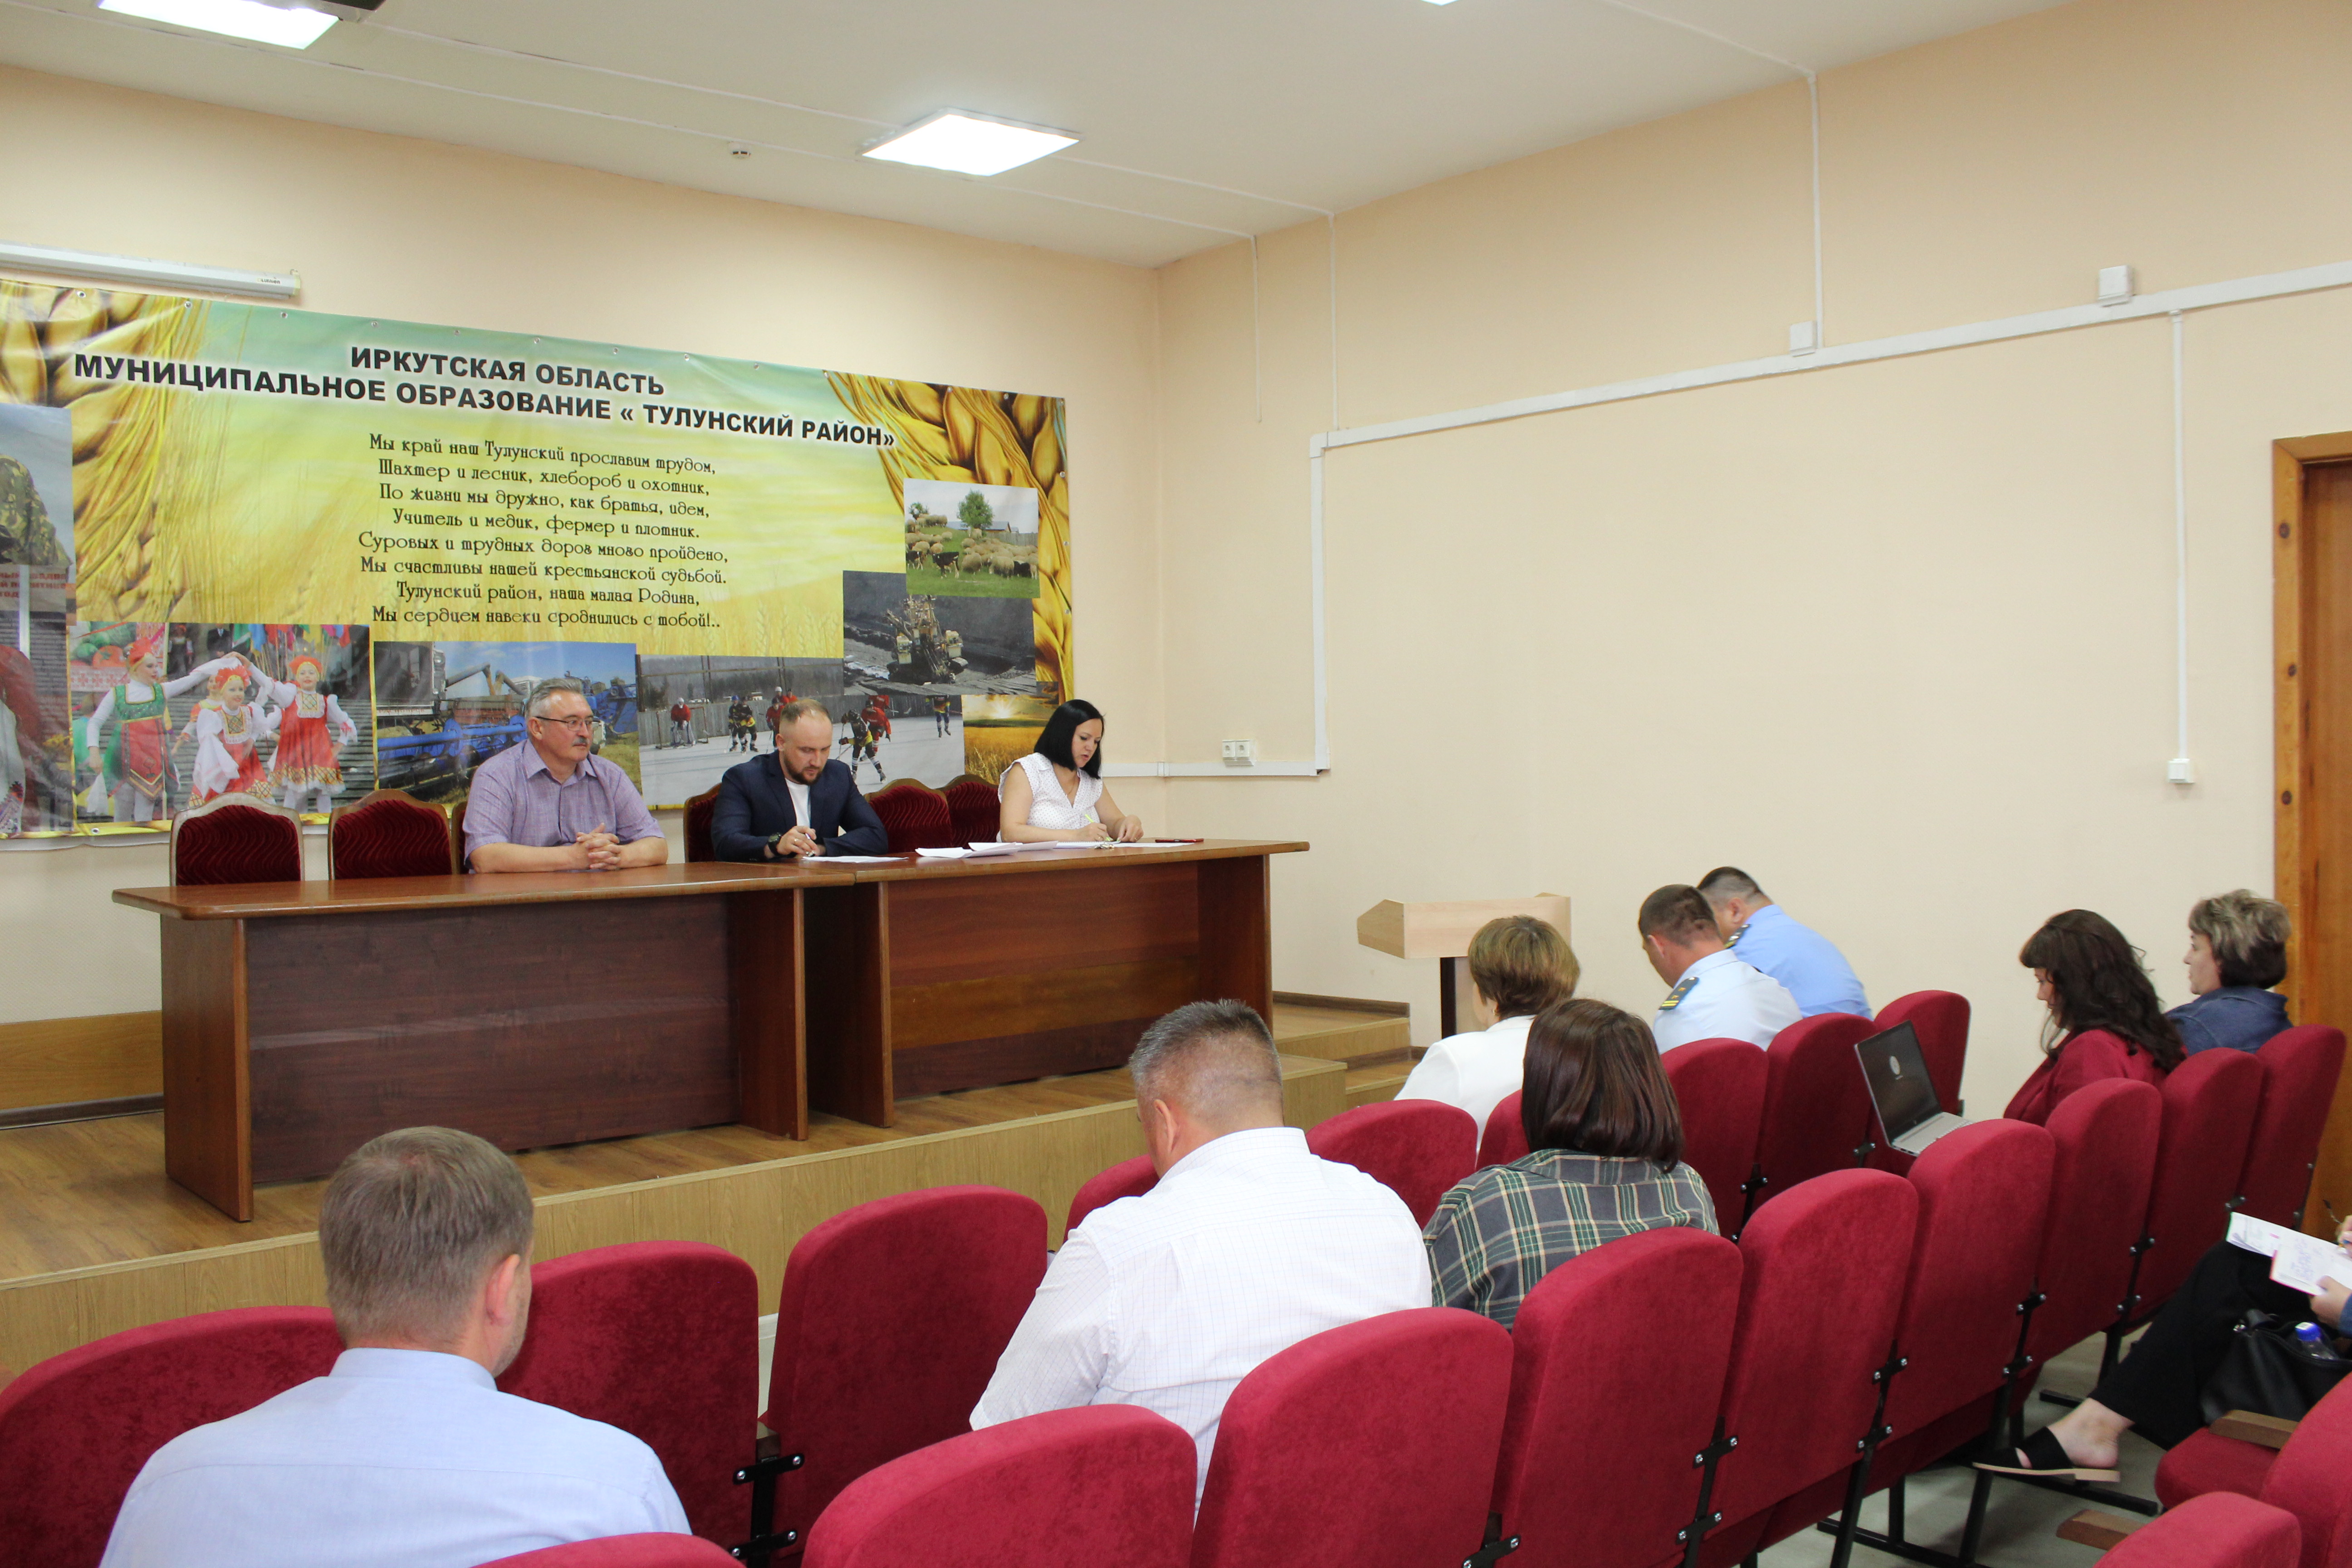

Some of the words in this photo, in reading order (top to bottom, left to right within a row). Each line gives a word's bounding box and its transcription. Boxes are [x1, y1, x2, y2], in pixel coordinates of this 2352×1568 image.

[351, 347, 525, 382] ИРКУТСКАЯ
[536, 363, 664, 395] ОБЛАСТЬ
[75, 354, 385, 402] МУНИЦИПАЛЬНОЕ
[397, 382, 611, 419] ОБРАЗОВАНИЕ
[643, 404, 793, 437] ТУЛУНСКИЙ
[802, 420, 894, 446] РАЙОН»
[369, 433, 394, 450] Мы
[402, 438, 442, 456] край
[449, 442, 479, 455] наш
[485, 440, 564, 462] Тулунский
[570, 451, 650, 467] прославим
[656, 457, 715, 474] трудом,
[378, 458, 450, 482] Шахтер
[457, 467, 466, 478] и
[471, 469, 532, 483] лесник,
[539, 470, 622, 490] хлебороб
[628, 478, 635, 489] и
[642, 480, 709, 495] охотник,
[380, 483, 403, 499] По
[411, 488, 461, 502] жизни
[467, 492, 488, 503] мы
[496, 490, 564, 509] дружно,
[570, 497, 595, 509] как
[601, 495, 663, 514] братья,
[670, 502, 709, 518] идем,
[392, 508, 462, 526] Учитель
[469, 516, 479, 526] и
[485, 514, 538, 530] медик,
[546, 514, 614, 537] фермер
[621, 523, 629, 534] и
[635, 524, 699, 538] плотник.
[358, 531, 438, 553] Суровых
[445, 539, 454, 550] и
[461, 537, 535, 555] трудных
[650, 546, 728, 563] пройдено,
[361, 556, 387, 572] Мы
[394, 562, 482, 574] счастливы
[489, 562, 537, 576] нашей
[544, 565, 655, 580] крестьянской
[662, 568, 726, 586] судьбой.
[397, 581, 481, 603] Тулунский
[488, 585, 542, 603] район,
[550, 589, 585, 600] наша
[591, 590, 632, 602] малая
[638, 588, 699, 606] Родина,
[372, 606, 397, 622] Мы
[404, 608, 479, 626] сердцем
[486, 611, 541, 622] навеки
[548, 610, 637, 627] сроднились
[644, 615, 652, 626] с
[658, 611, 720, 627] тобой!..
